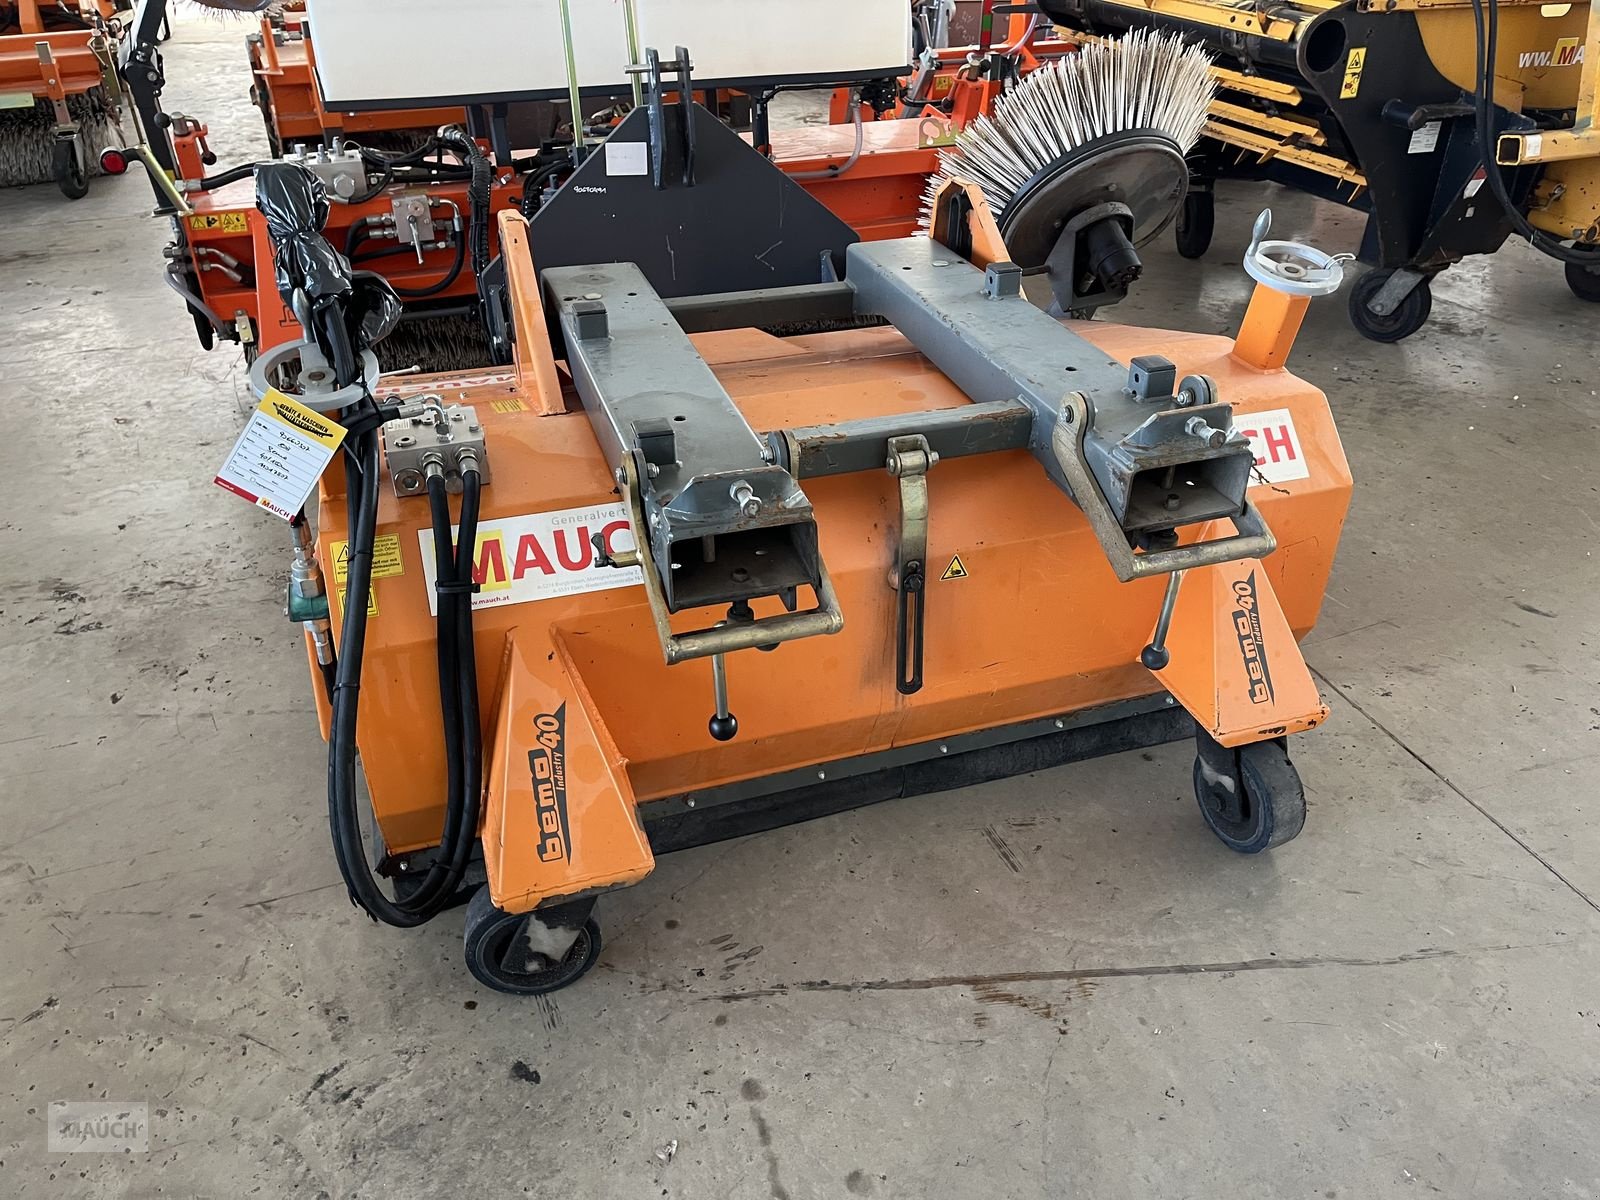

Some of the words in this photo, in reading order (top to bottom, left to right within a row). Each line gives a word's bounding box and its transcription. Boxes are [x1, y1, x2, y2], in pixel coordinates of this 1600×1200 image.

[261, 499, 290, 518] MAUCH
[1232, 581, 1254, 610] 40
[1250, 612, 1263, 645] Industry
[533, 713, 561, 750] 40
[553, 751, 565, 791] Industry
[528, 749, 563, 862] bema
